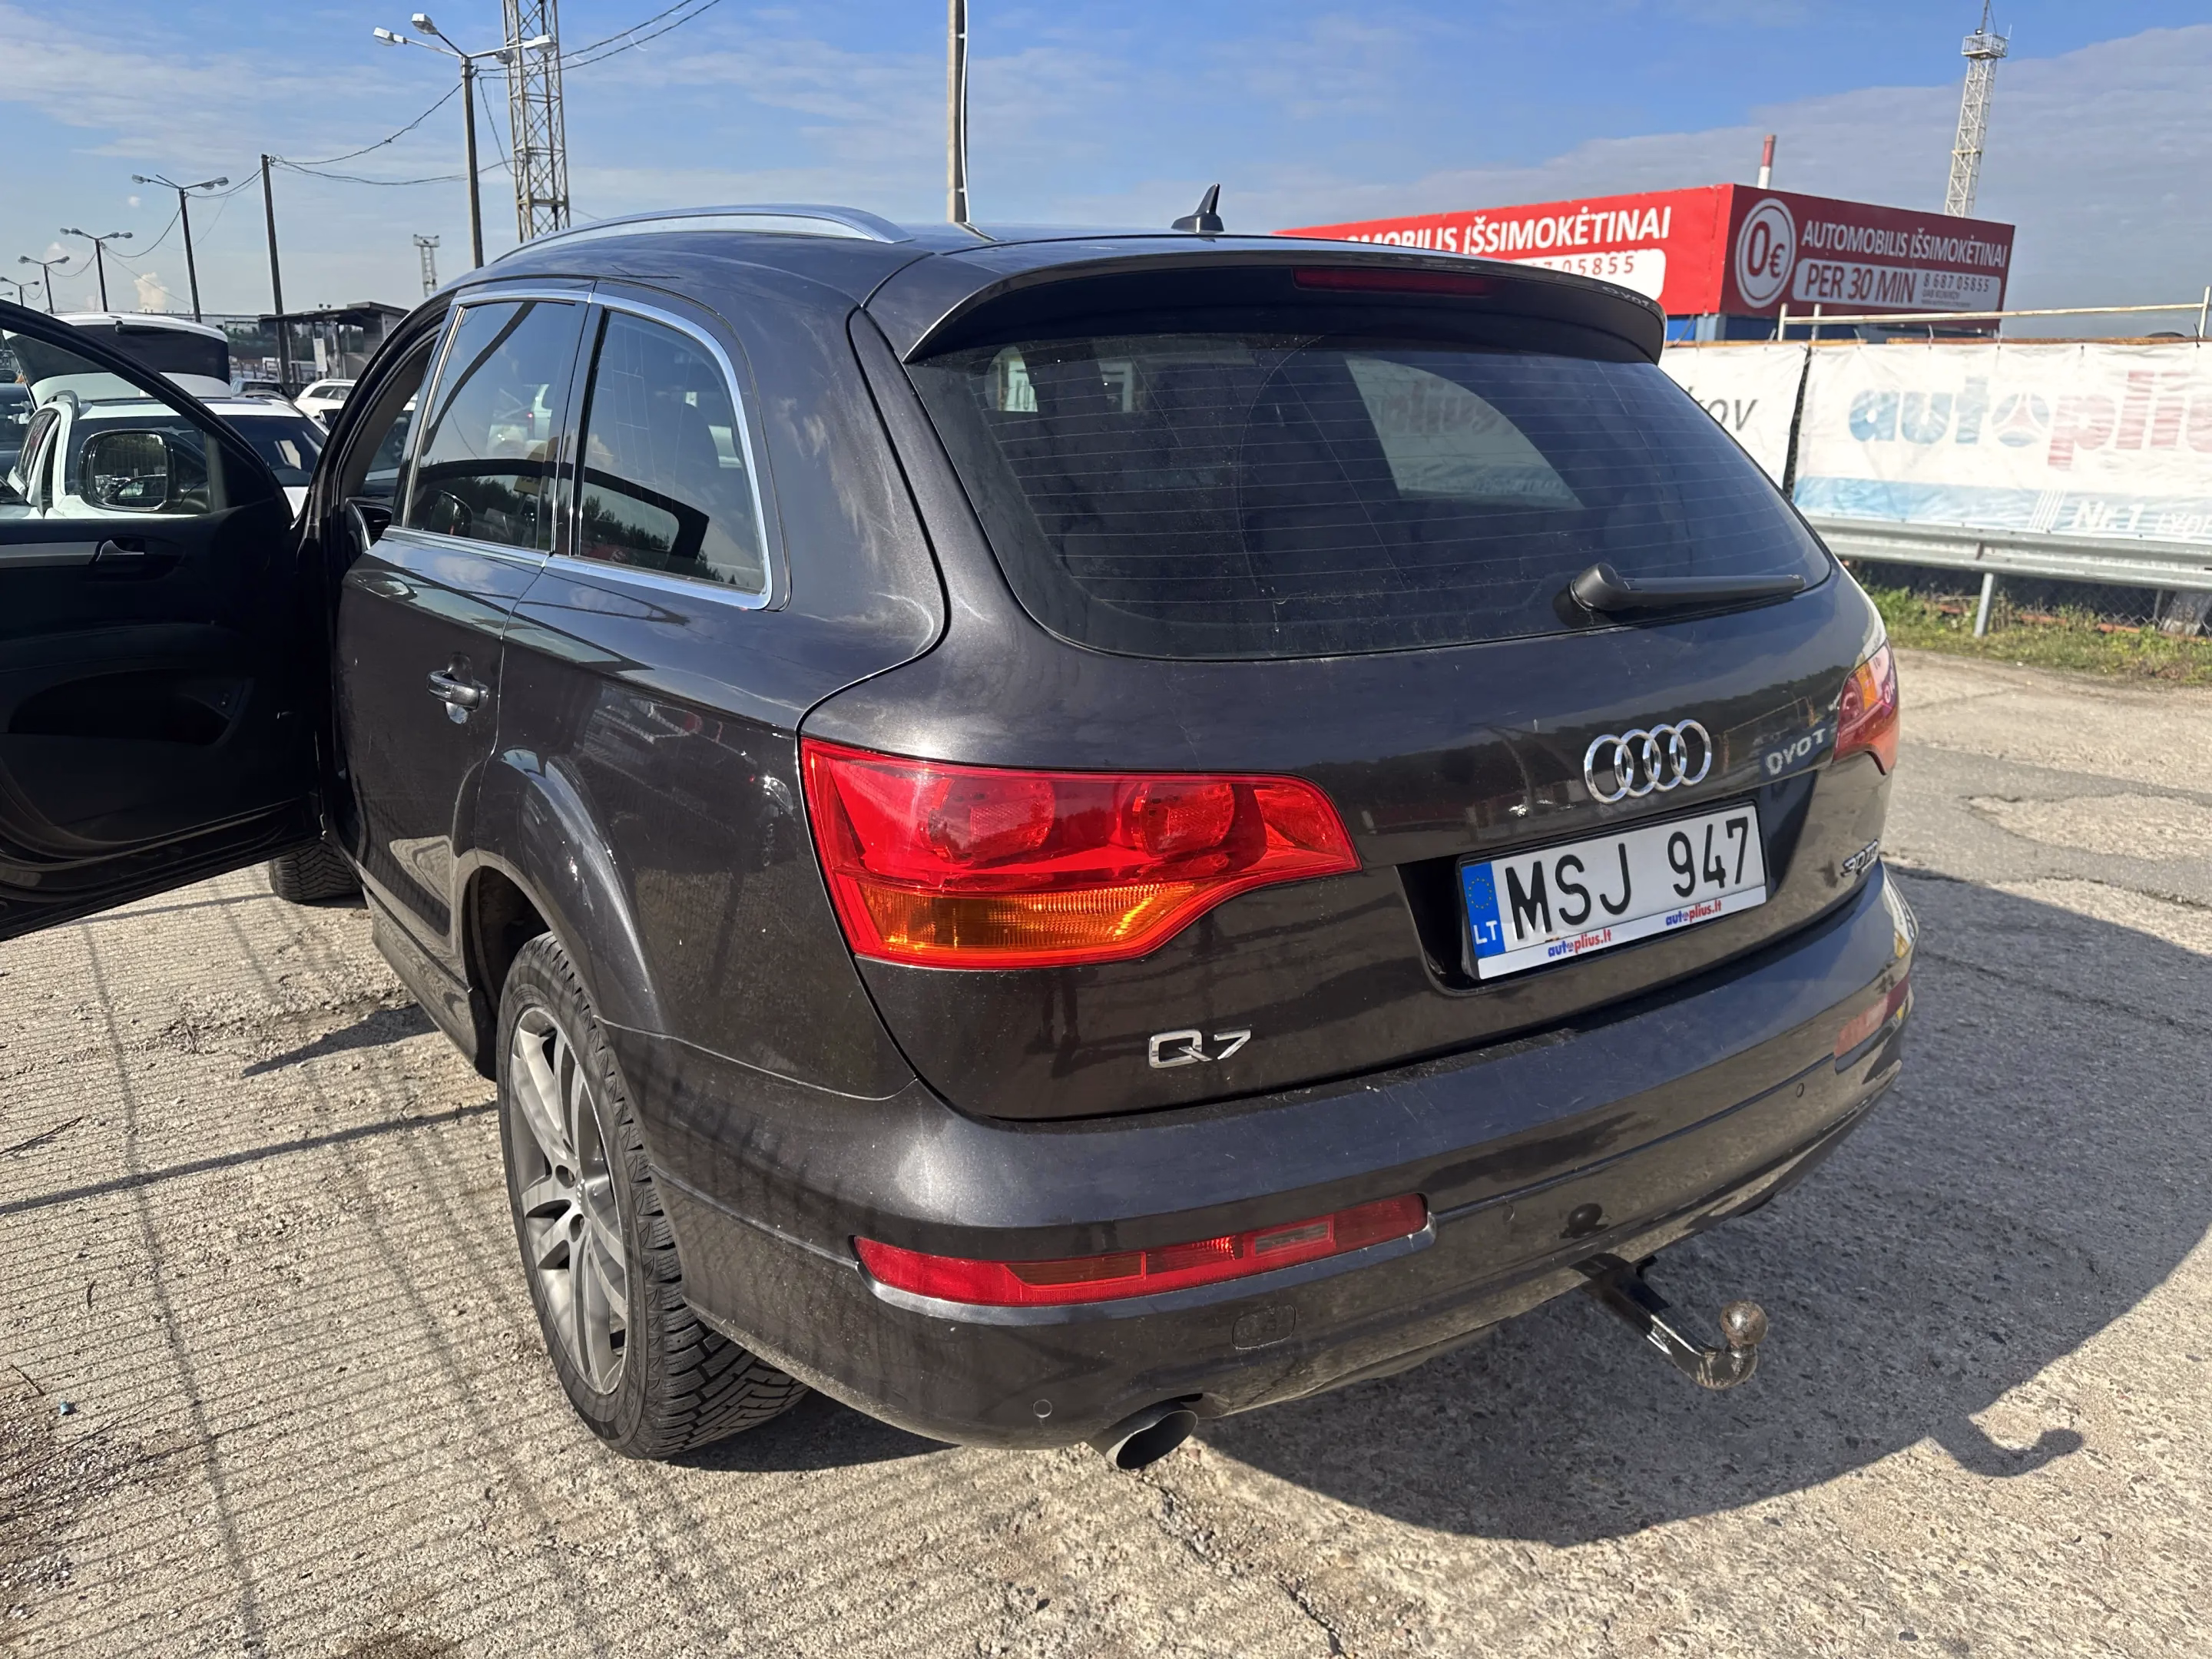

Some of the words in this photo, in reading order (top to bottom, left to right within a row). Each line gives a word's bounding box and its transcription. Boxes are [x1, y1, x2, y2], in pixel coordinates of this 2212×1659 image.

[1800, 220, 1907, 257] AUTOMOBILIS
[1909, 227, 2007, 267] IŠSIMOKĖTINAI
[1804, 263, 1845, 297] PER
[1846, 267, 1873, 300] 30
[1874, 270, 1918, 303] MIN
[1505, 843, 1631, 940] MSJ
[1667, 816, 1749, 898] 947
[1474, 920, 1498, 945] LT
[1148, 1028, 1251, 1069] Q7
